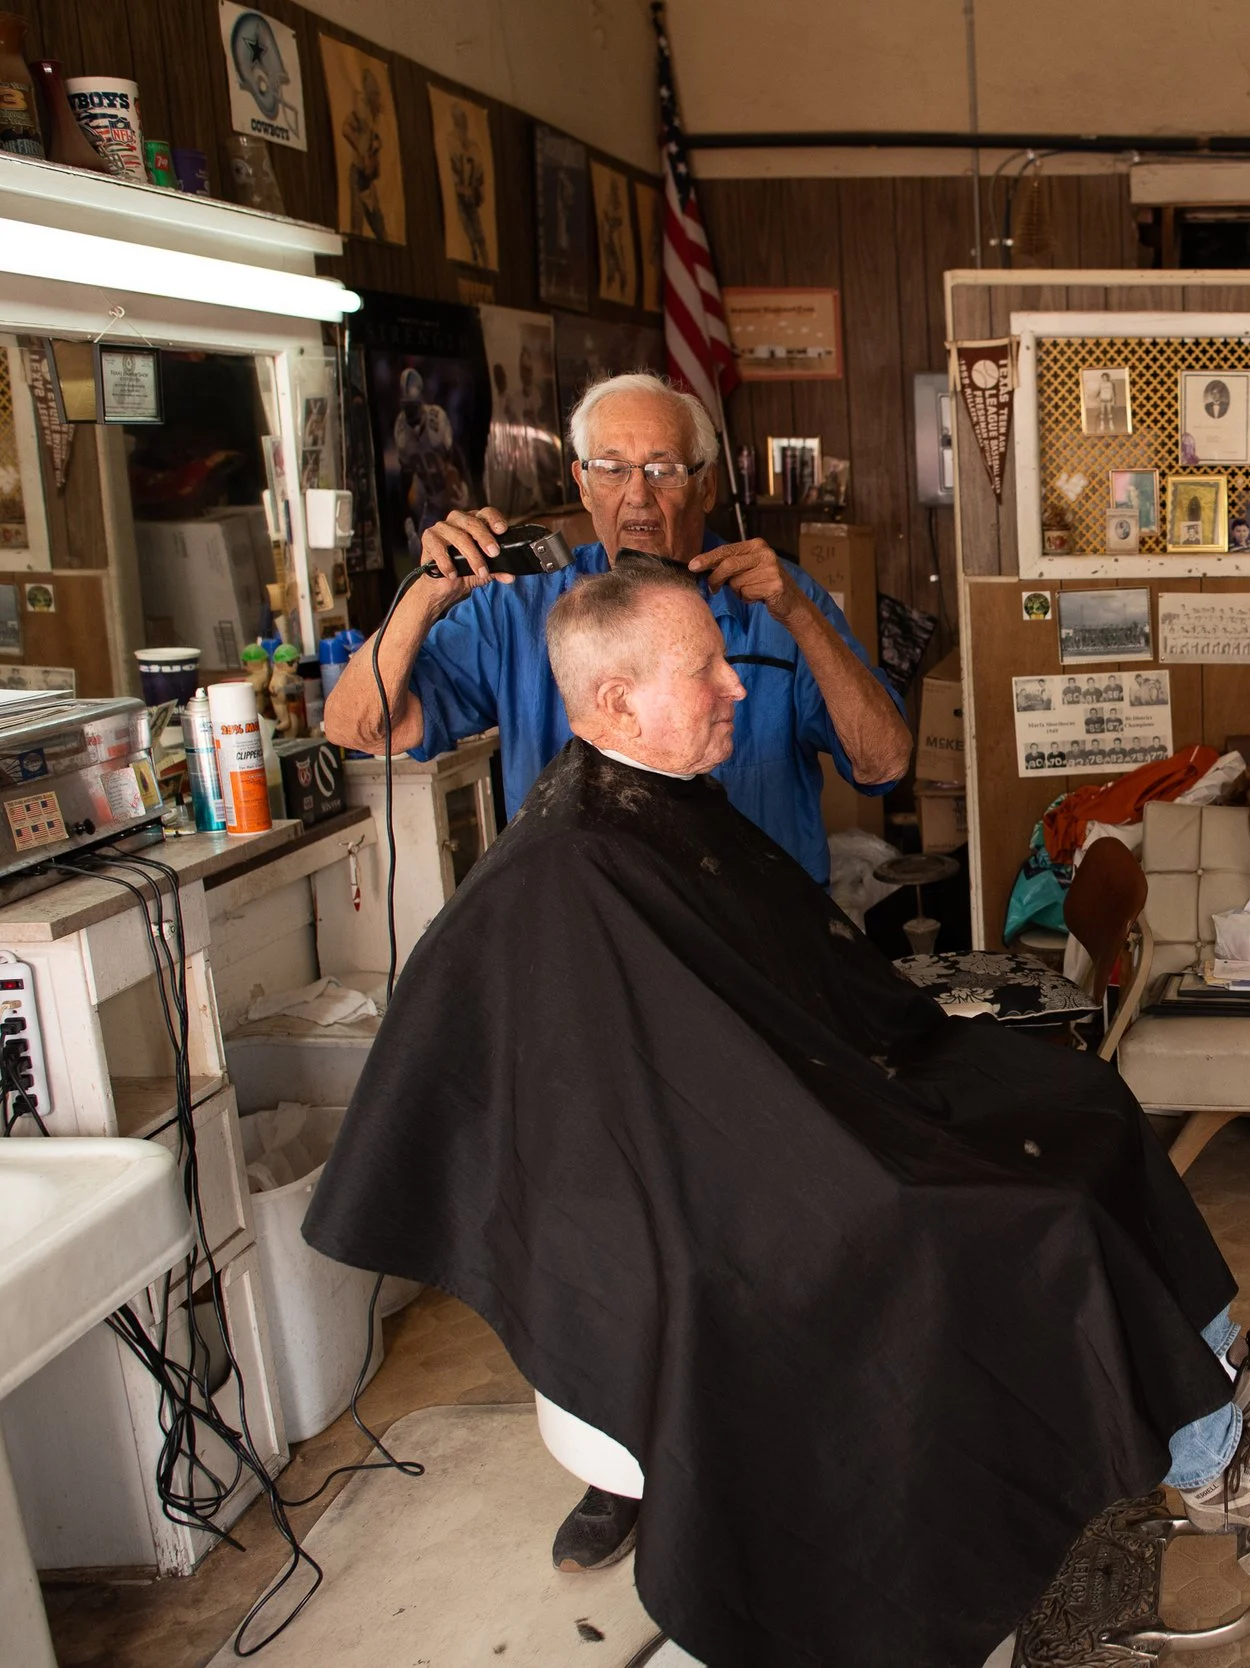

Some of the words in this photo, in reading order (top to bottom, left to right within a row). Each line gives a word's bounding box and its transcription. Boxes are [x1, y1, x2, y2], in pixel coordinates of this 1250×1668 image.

[251, 118, 290, 141] COWBOYS
[999, 360, 1009, 403] TEXAS
[974, 390, 988, 441] FRESHMAN
[985, 390, 998, 437] LEAGUE
[999, 409, 1008, 438] TEEN
[990, 439, 1000, 476] BASEBALL
